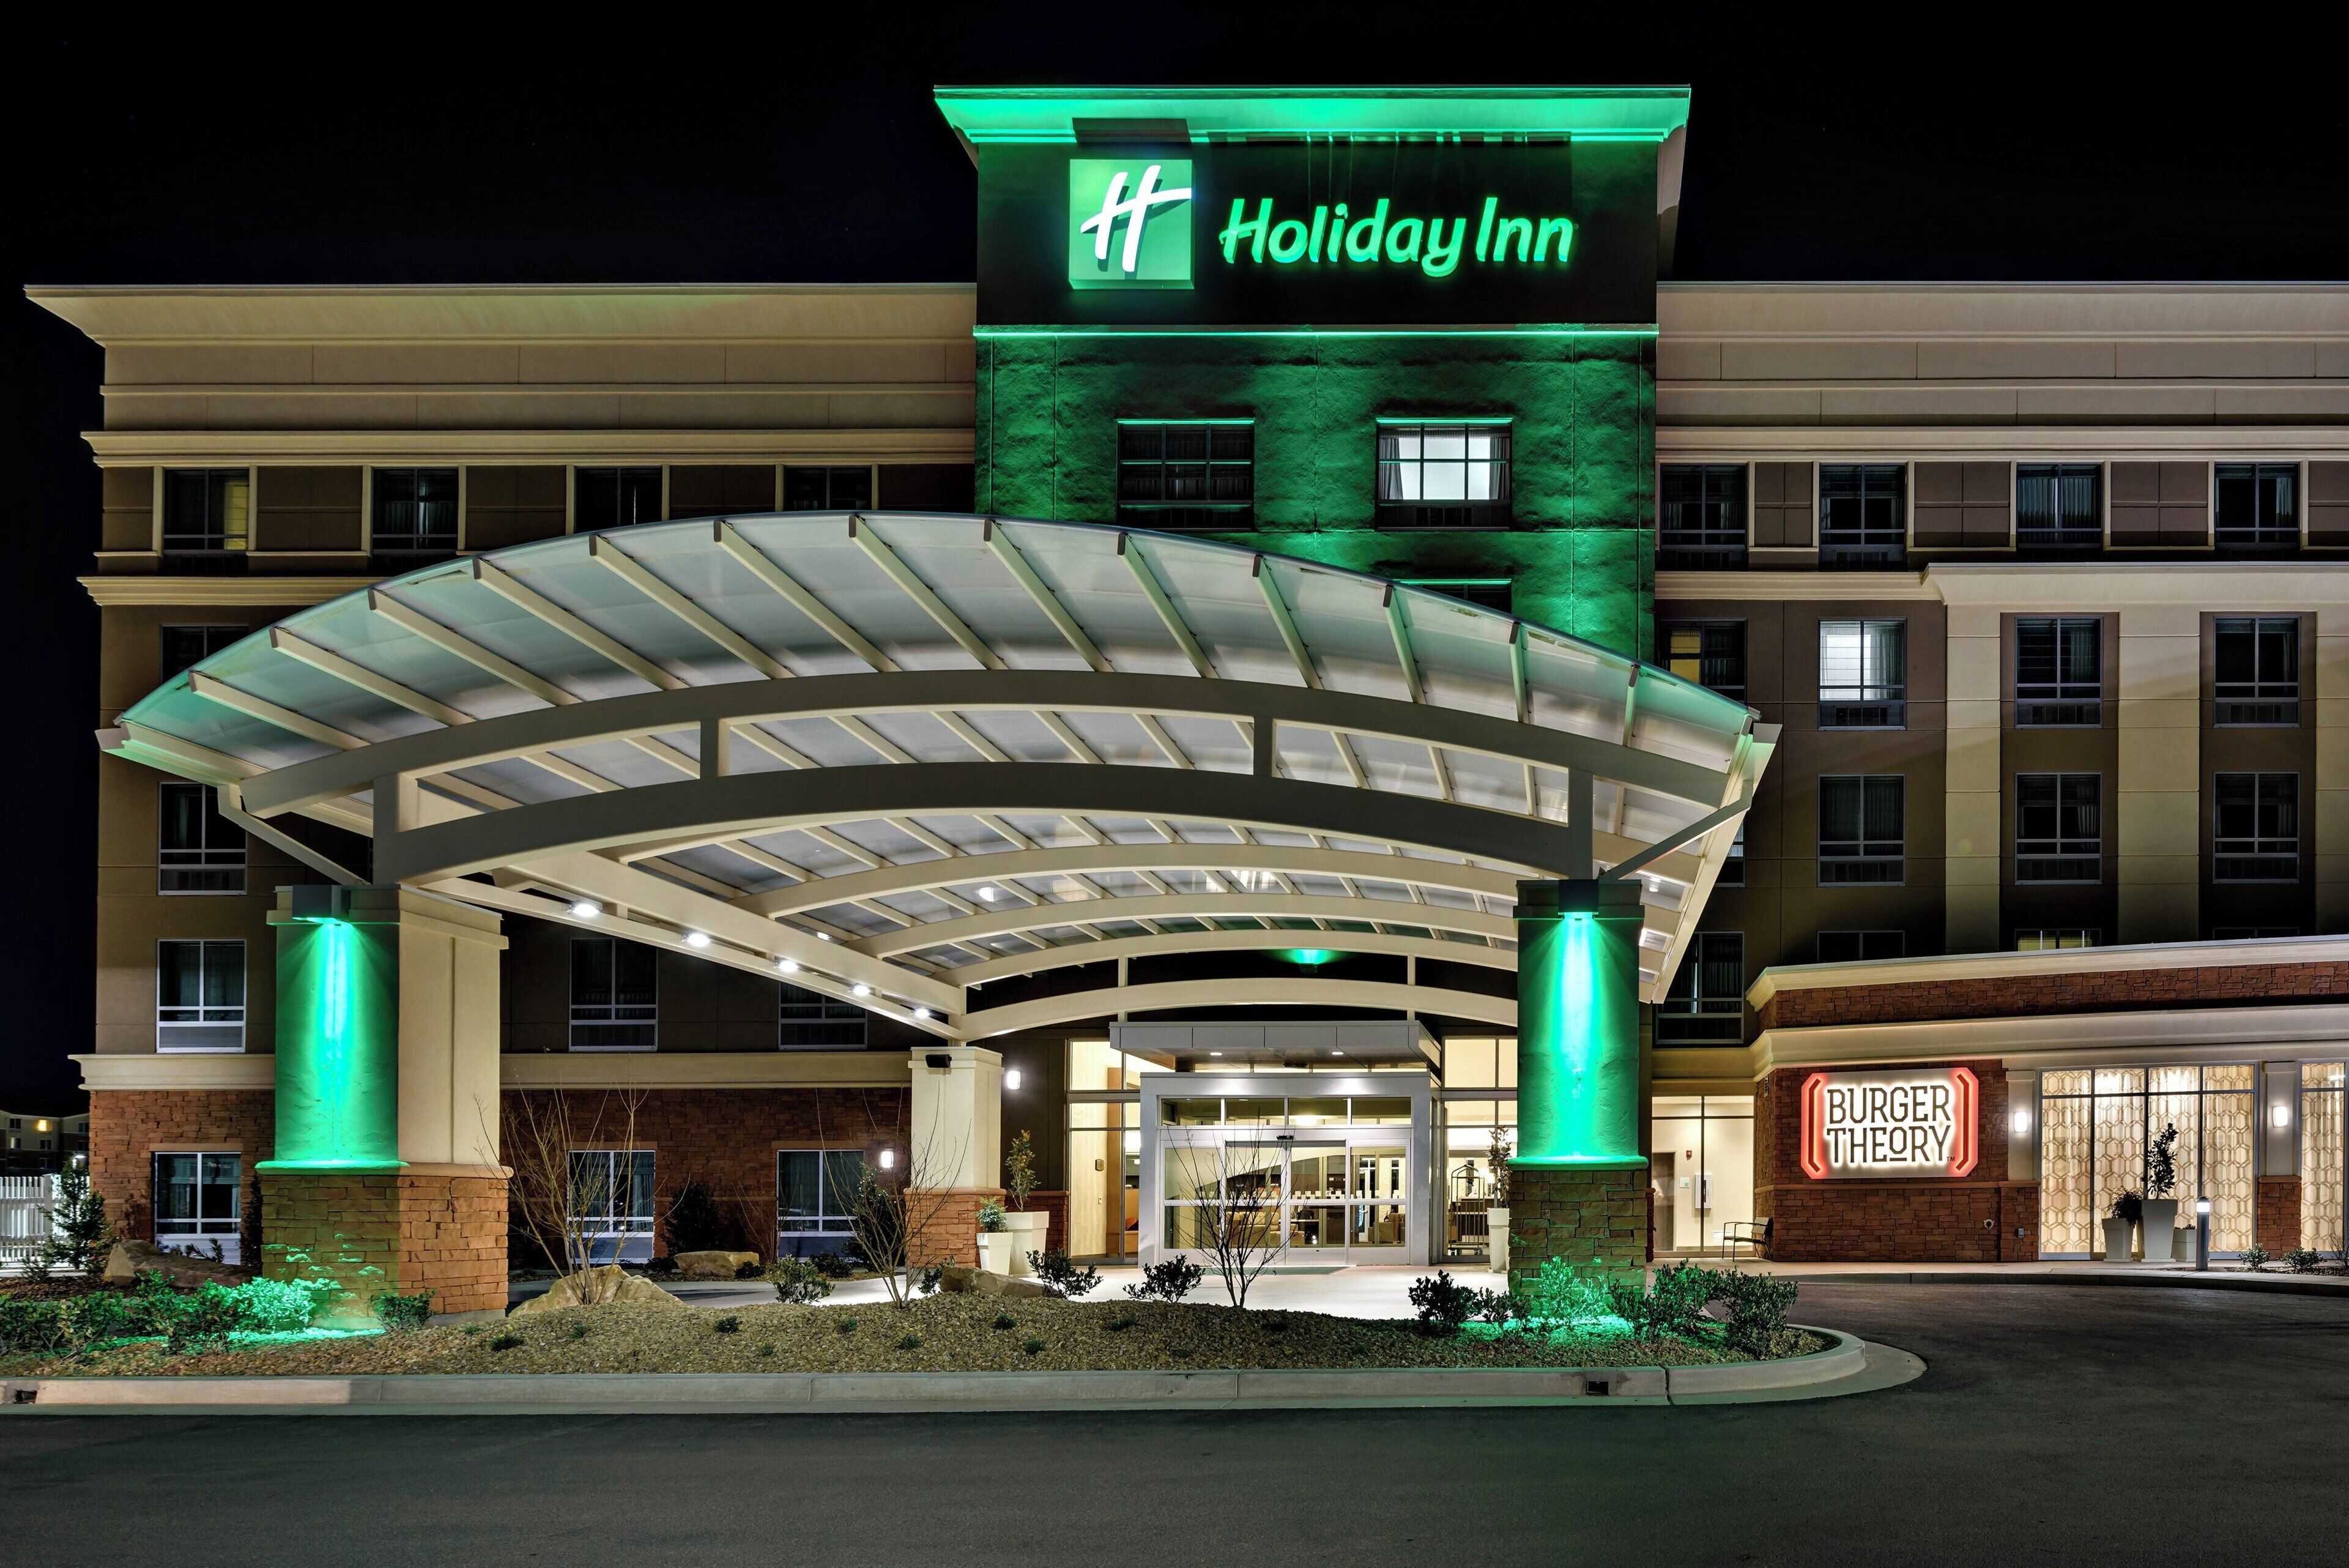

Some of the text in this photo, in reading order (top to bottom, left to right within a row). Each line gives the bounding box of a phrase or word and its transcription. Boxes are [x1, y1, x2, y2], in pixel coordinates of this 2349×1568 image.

[1219, 197, 1573, 277] Holiday Inn
[1827, 1085, 1951, 1124] BURGER
[1827, 1124, 1951, 1163] THEORY
